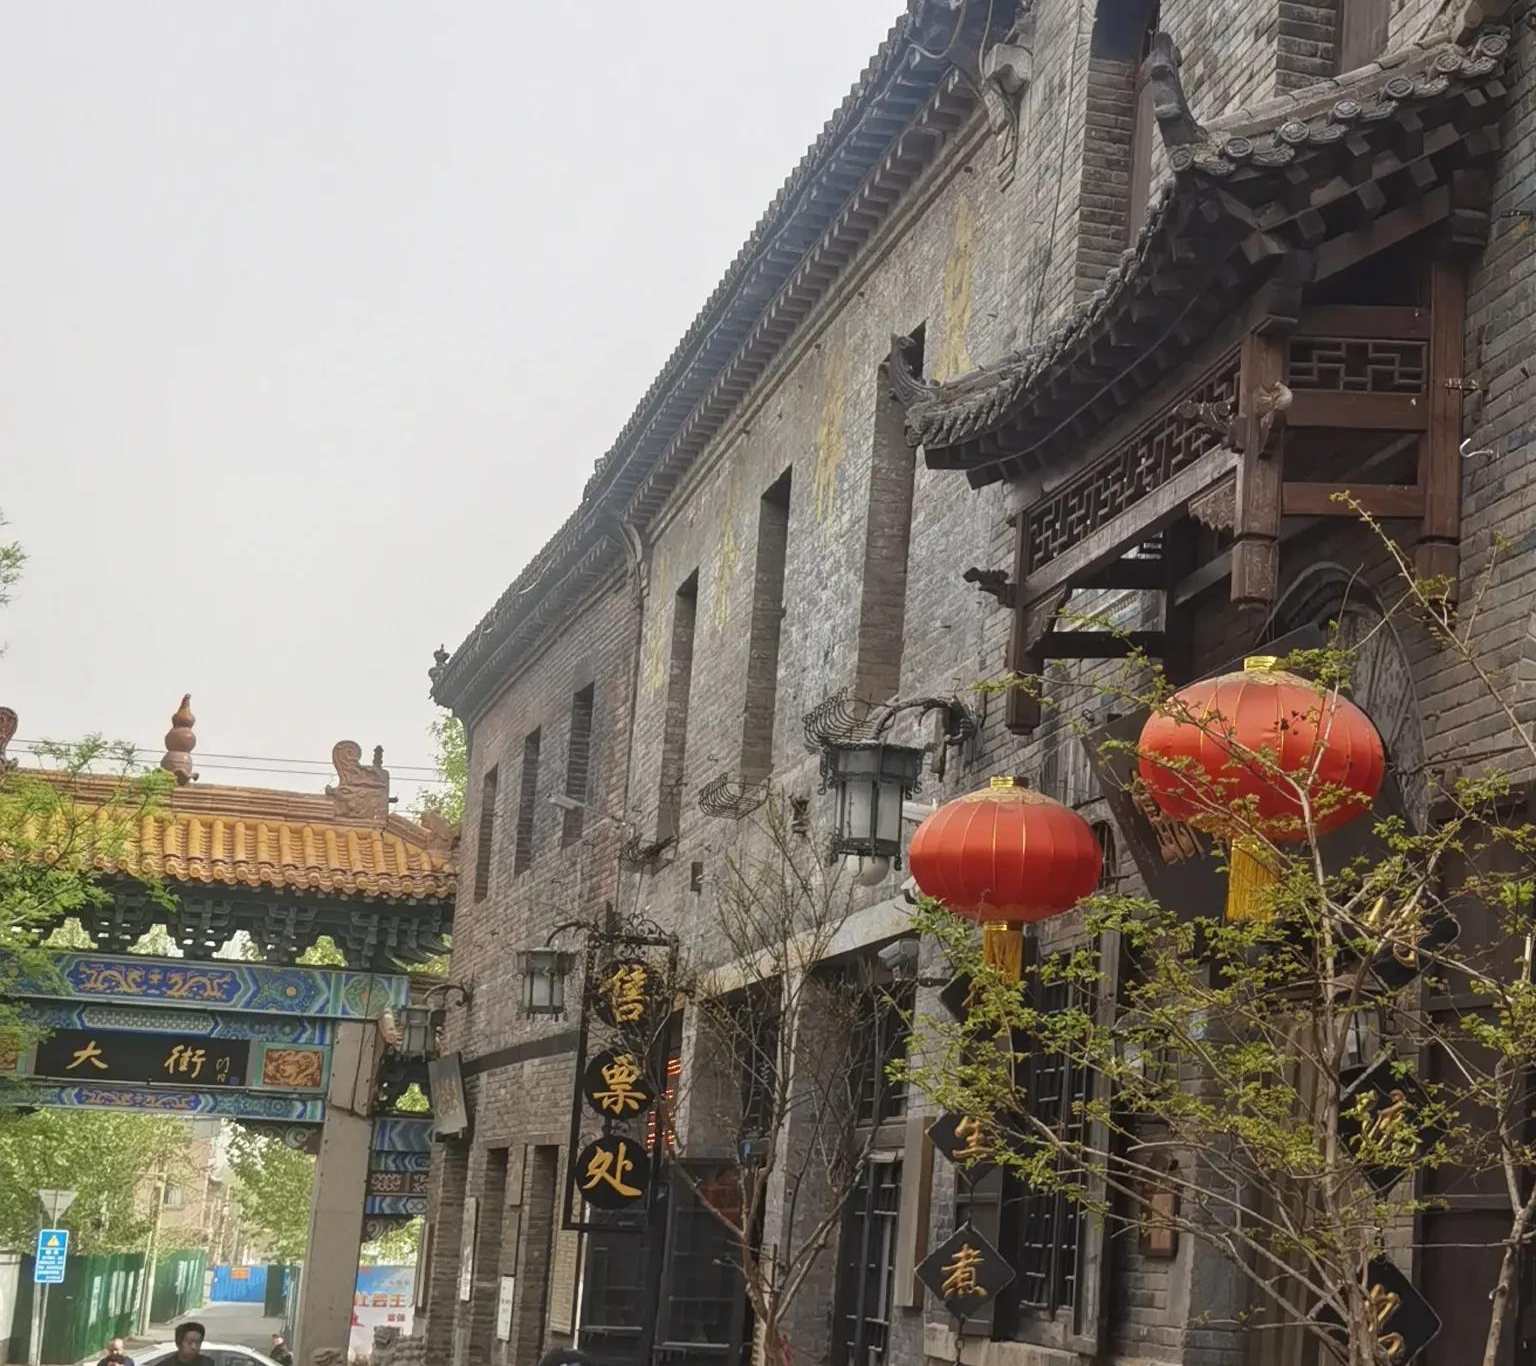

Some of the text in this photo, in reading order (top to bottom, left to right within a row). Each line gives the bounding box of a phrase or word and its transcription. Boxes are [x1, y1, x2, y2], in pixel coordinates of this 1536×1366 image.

[65, 1040, 207, 1078] 大街
[582, 963, 650, 1197] 售票处
